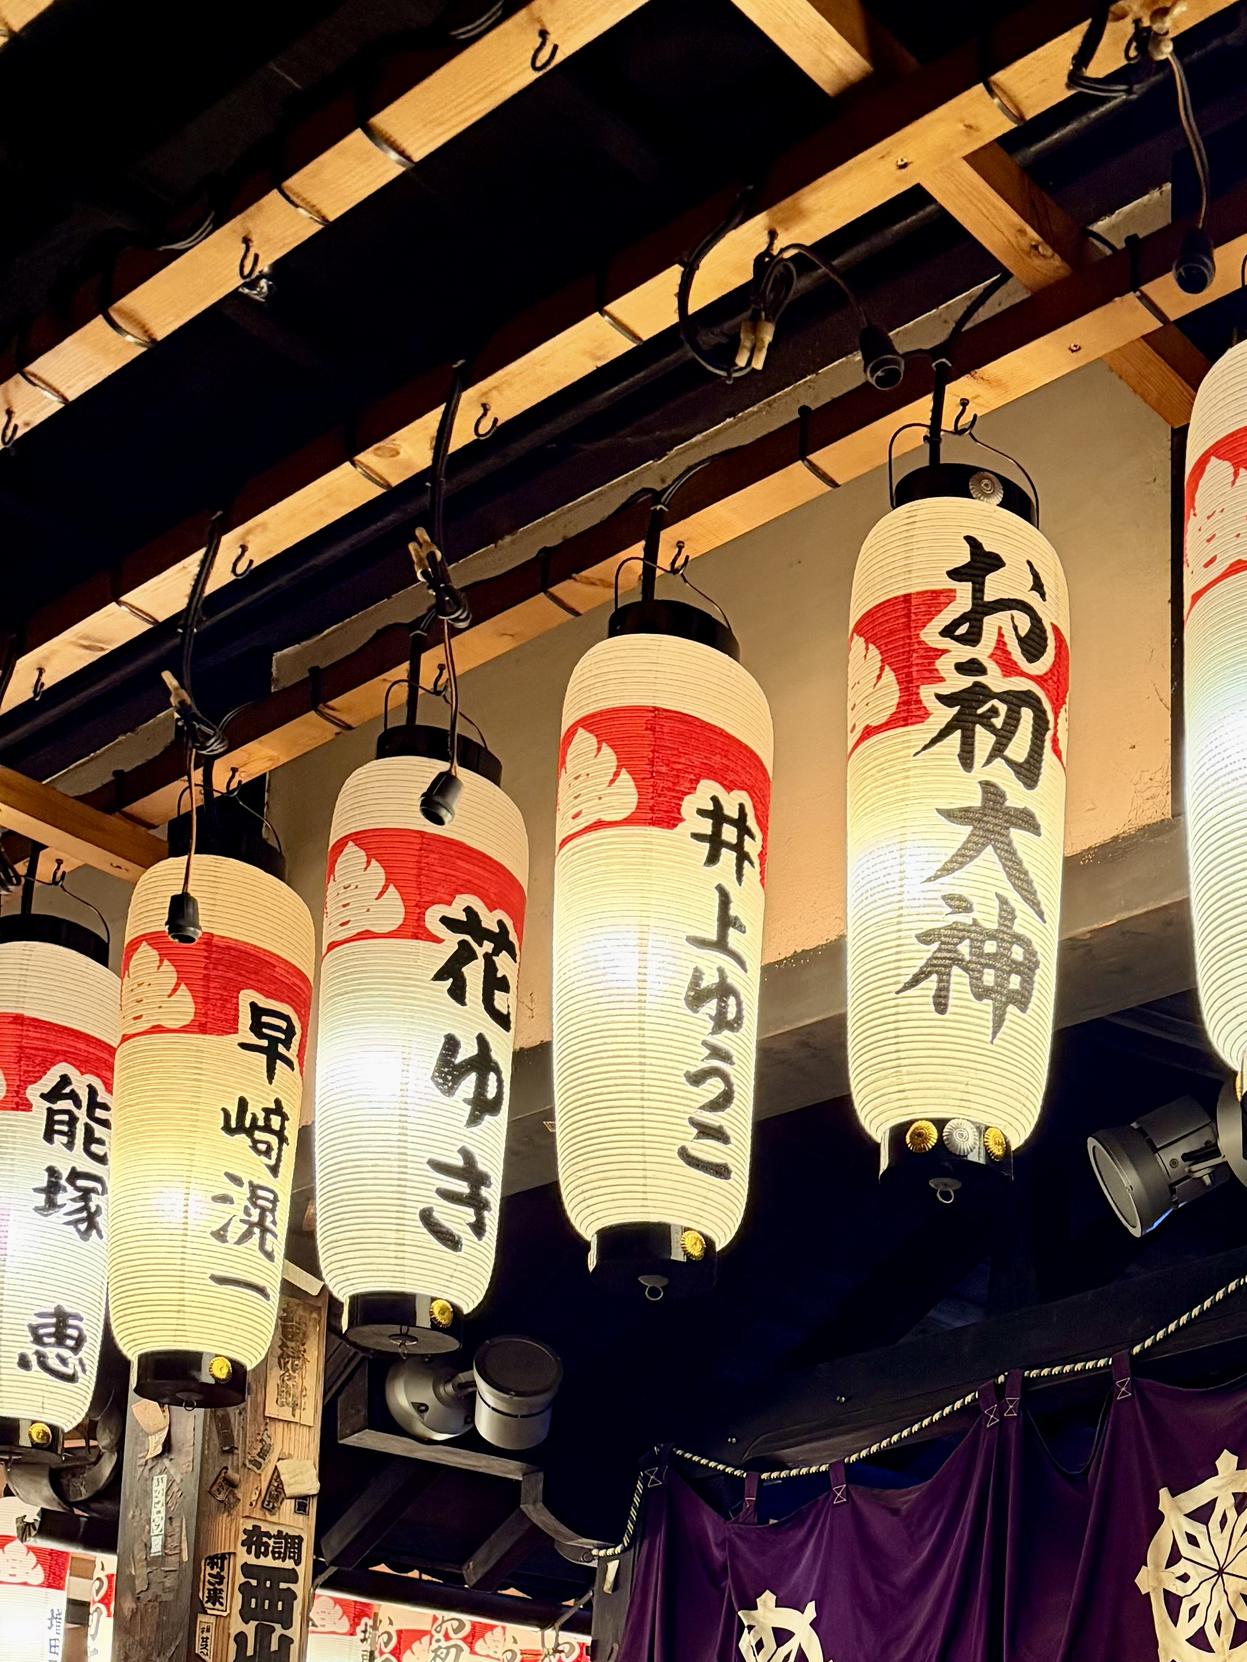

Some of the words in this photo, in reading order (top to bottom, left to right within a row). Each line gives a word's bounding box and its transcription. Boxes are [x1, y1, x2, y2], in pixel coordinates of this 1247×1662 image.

[895, 534, 1052, 1044] お初大神
[419, 905, 517, 1253] 花ゆき
[676, 794, 758, 1181] 井上ゆうこ
